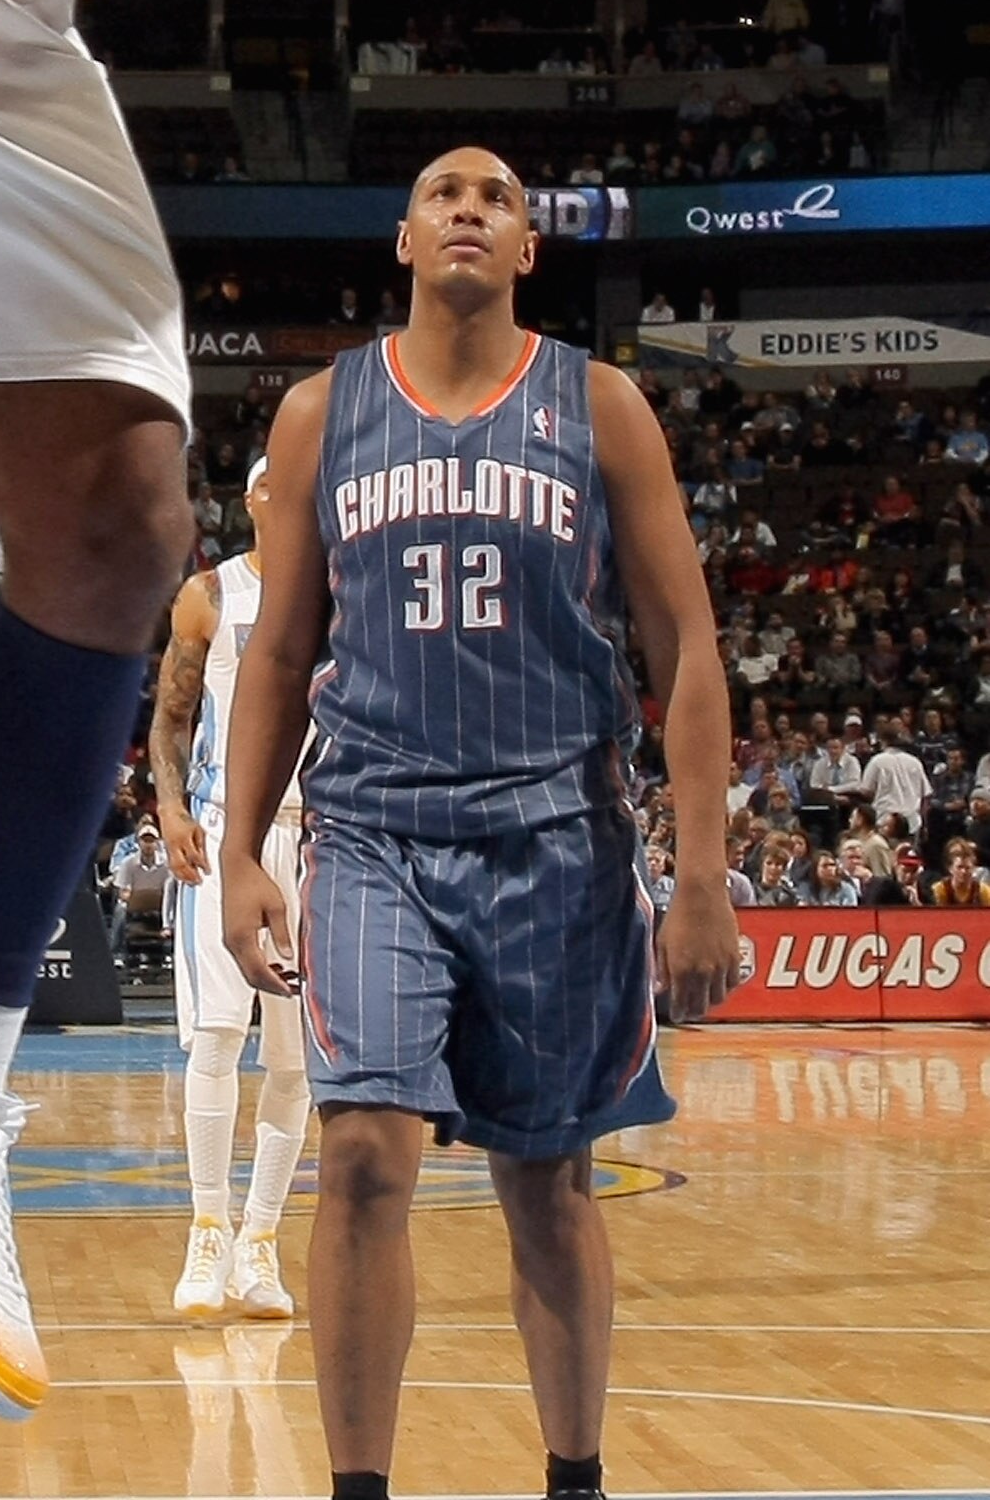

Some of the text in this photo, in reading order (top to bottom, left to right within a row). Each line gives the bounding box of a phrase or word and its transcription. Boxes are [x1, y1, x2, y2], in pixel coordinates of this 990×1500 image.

[686, 206, 785, 236] Qwest
[761, 331, 866, 356] EDDIE'S
[875, 329, 939, 352] KIDS
[334, 456, 578, 544] CHARLOTTE
[401, 542, 506, 631] 32
[35, 962, 73, 979] est
[766, 933, 967, 990] LUCAS
